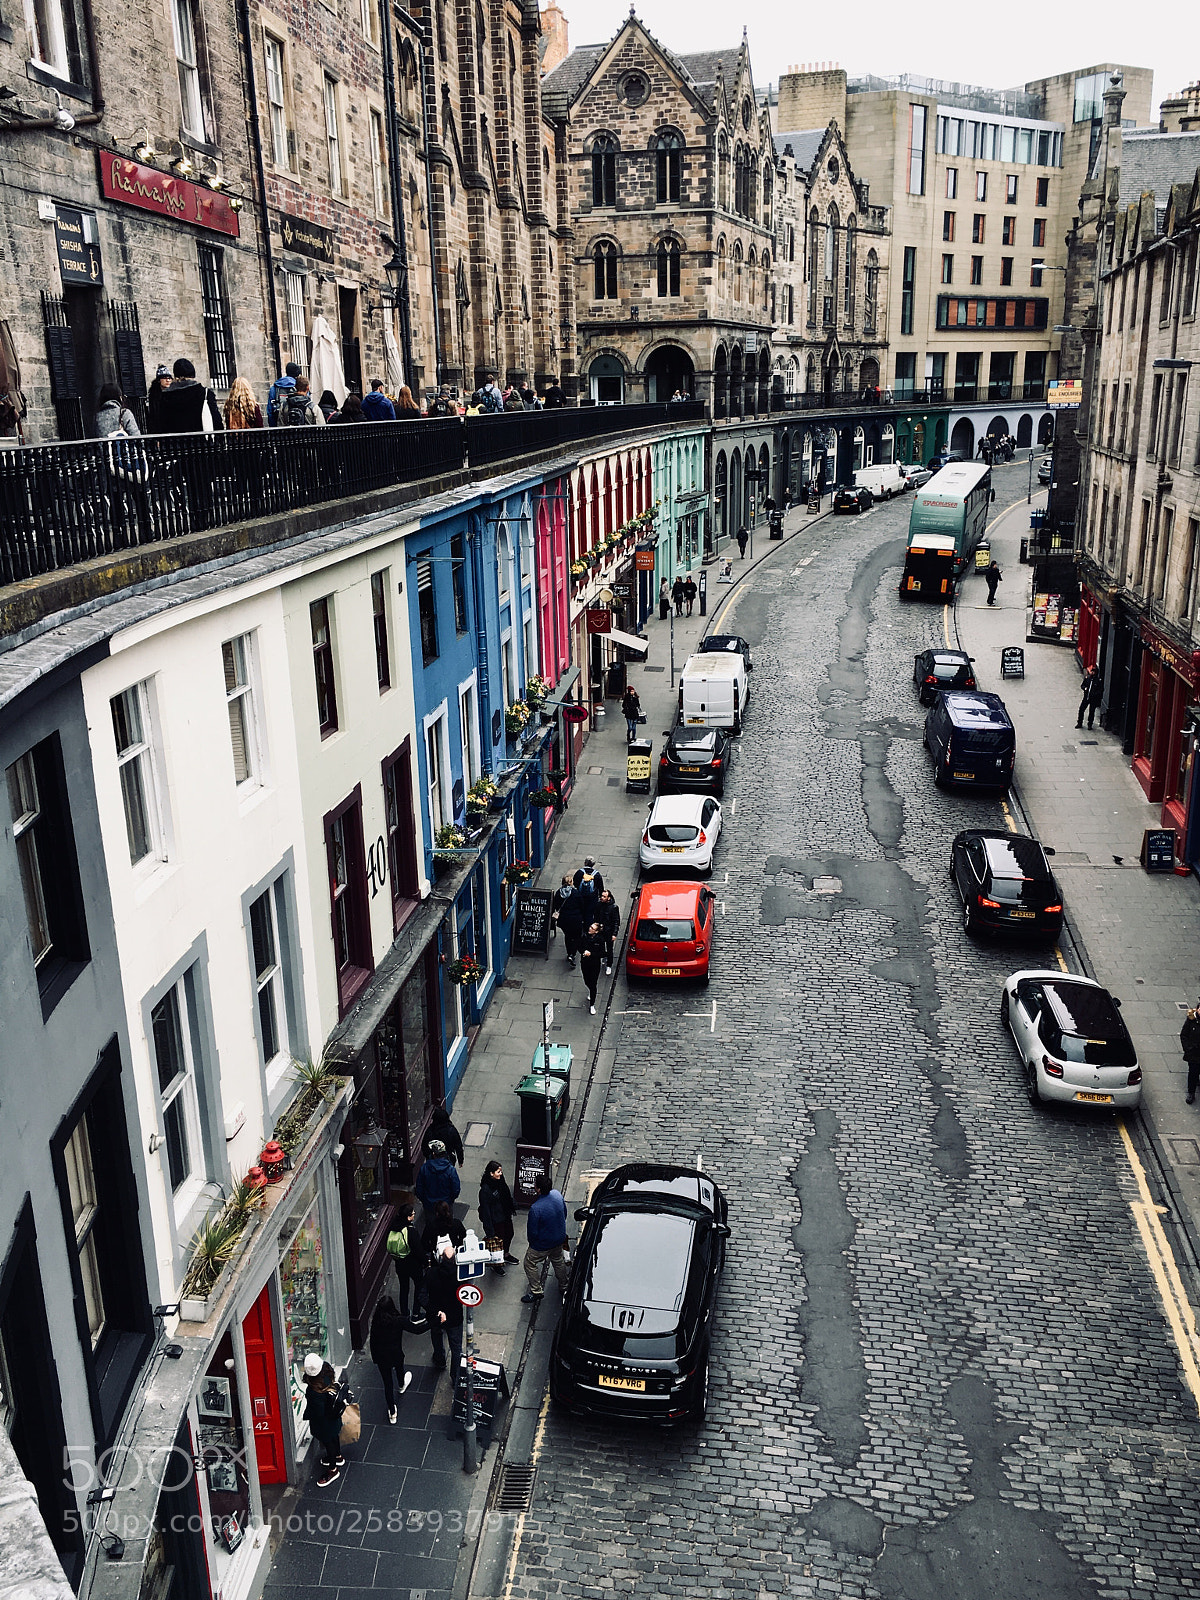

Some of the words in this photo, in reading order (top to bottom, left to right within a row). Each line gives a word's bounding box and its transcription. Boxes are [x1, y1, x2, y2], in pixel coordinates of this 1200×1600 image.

[60, 239, 83, 253] SHISHA
[62, 258, 87, 273] TERRACE
[367, 835, 386, 900] 40
[460, 1290, 480, 1301] 20
[587, 1361, 619, 1371] RANGE
[624, 1366, 657, 1374] ROVER
[626, 1379, 642, 1388] VRG
[255, 1420, 270, 1431] 42
